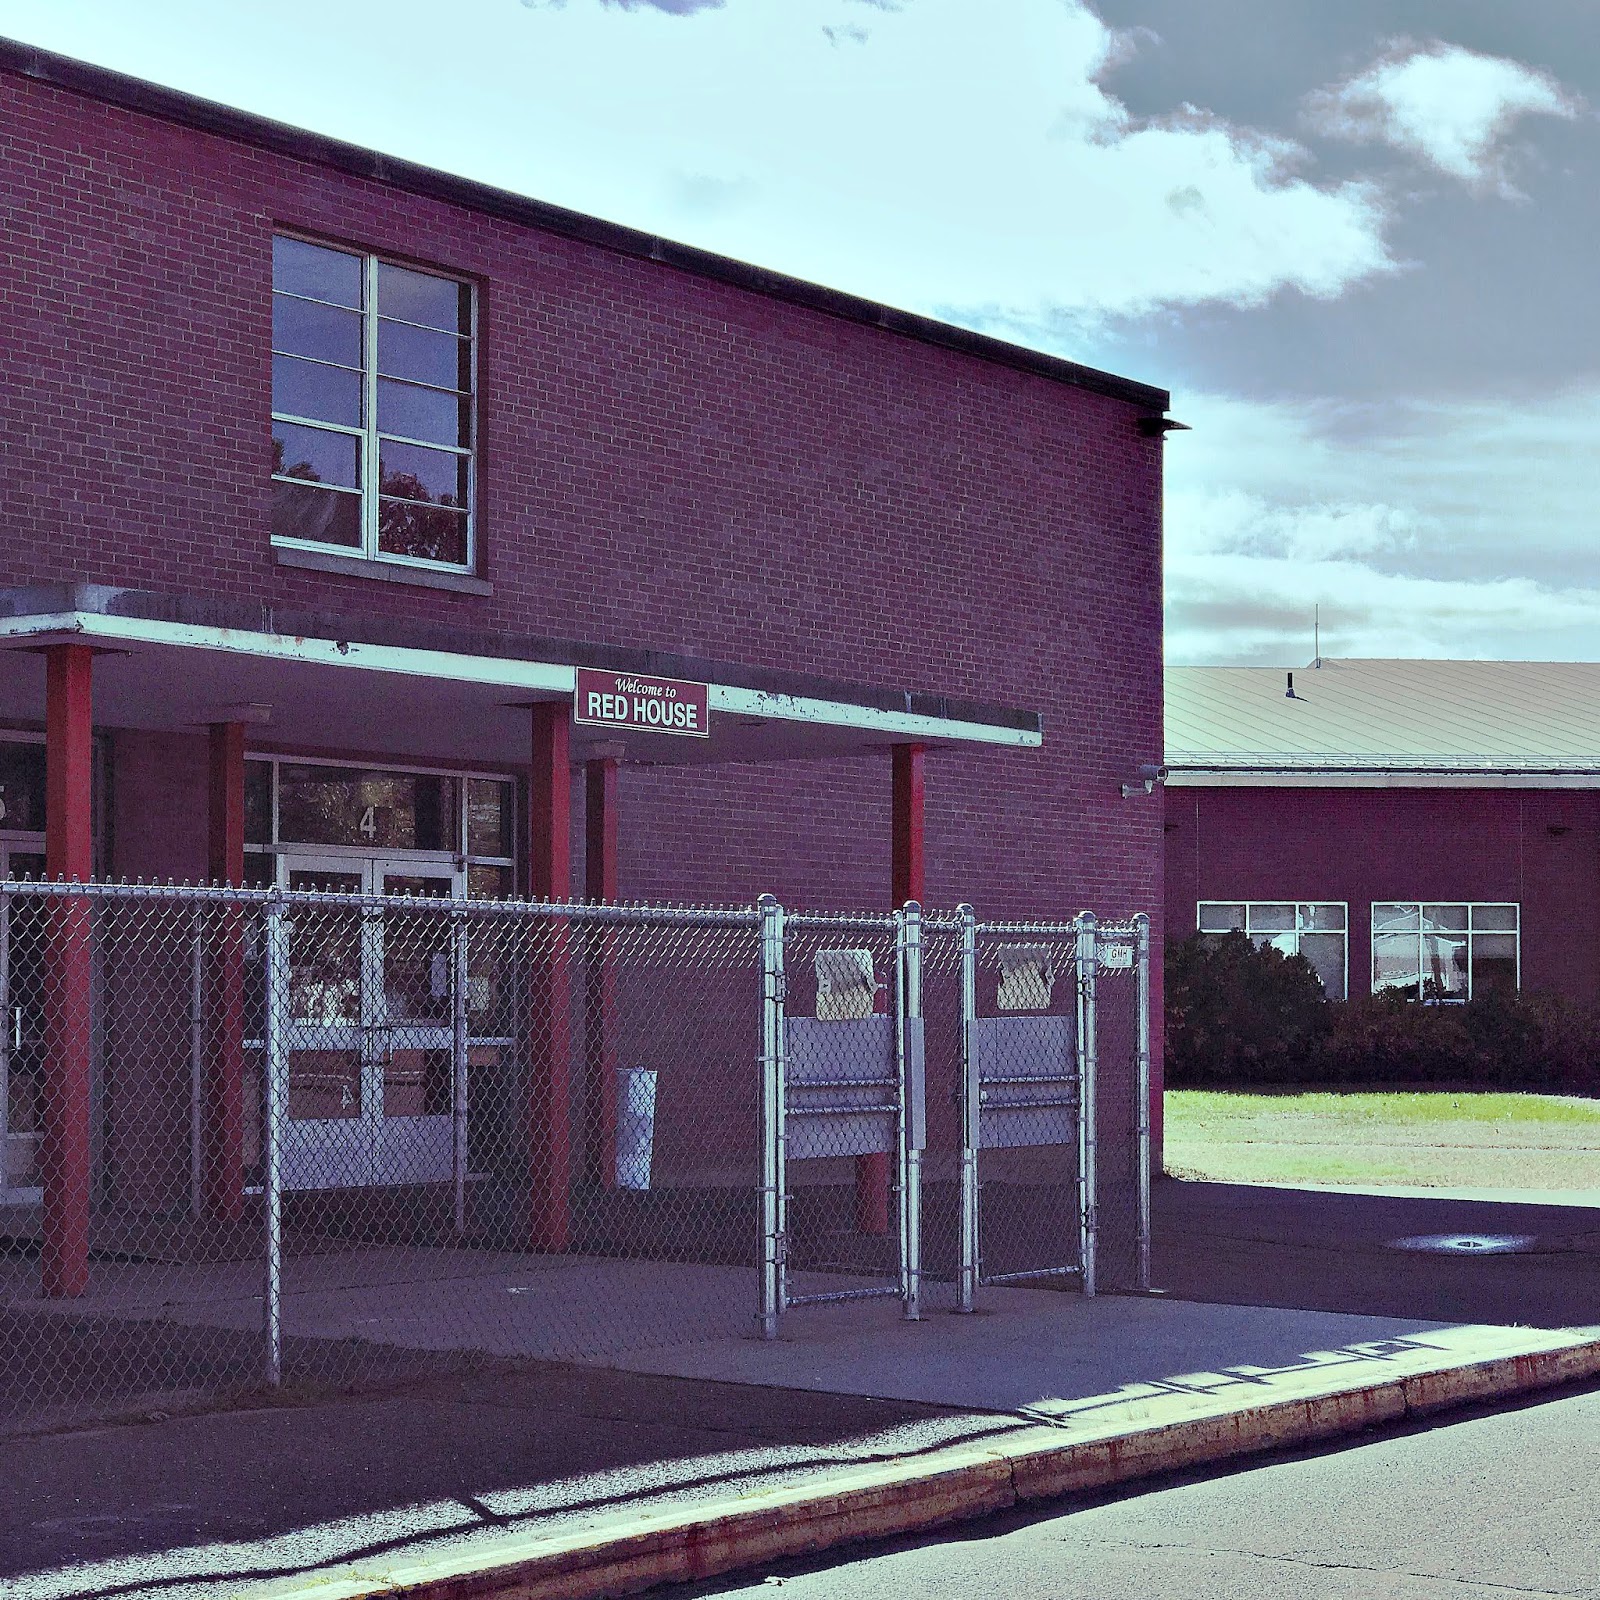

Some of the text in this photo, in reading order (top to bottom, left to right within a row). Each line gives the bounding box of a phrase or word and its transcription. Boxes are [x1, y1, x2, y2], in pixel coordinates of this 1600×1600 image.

[615, 678, 677, 698] Welcome to
[588, 692, 698, 729] RED HOUSE
[360, 806, 377, 840] 4
